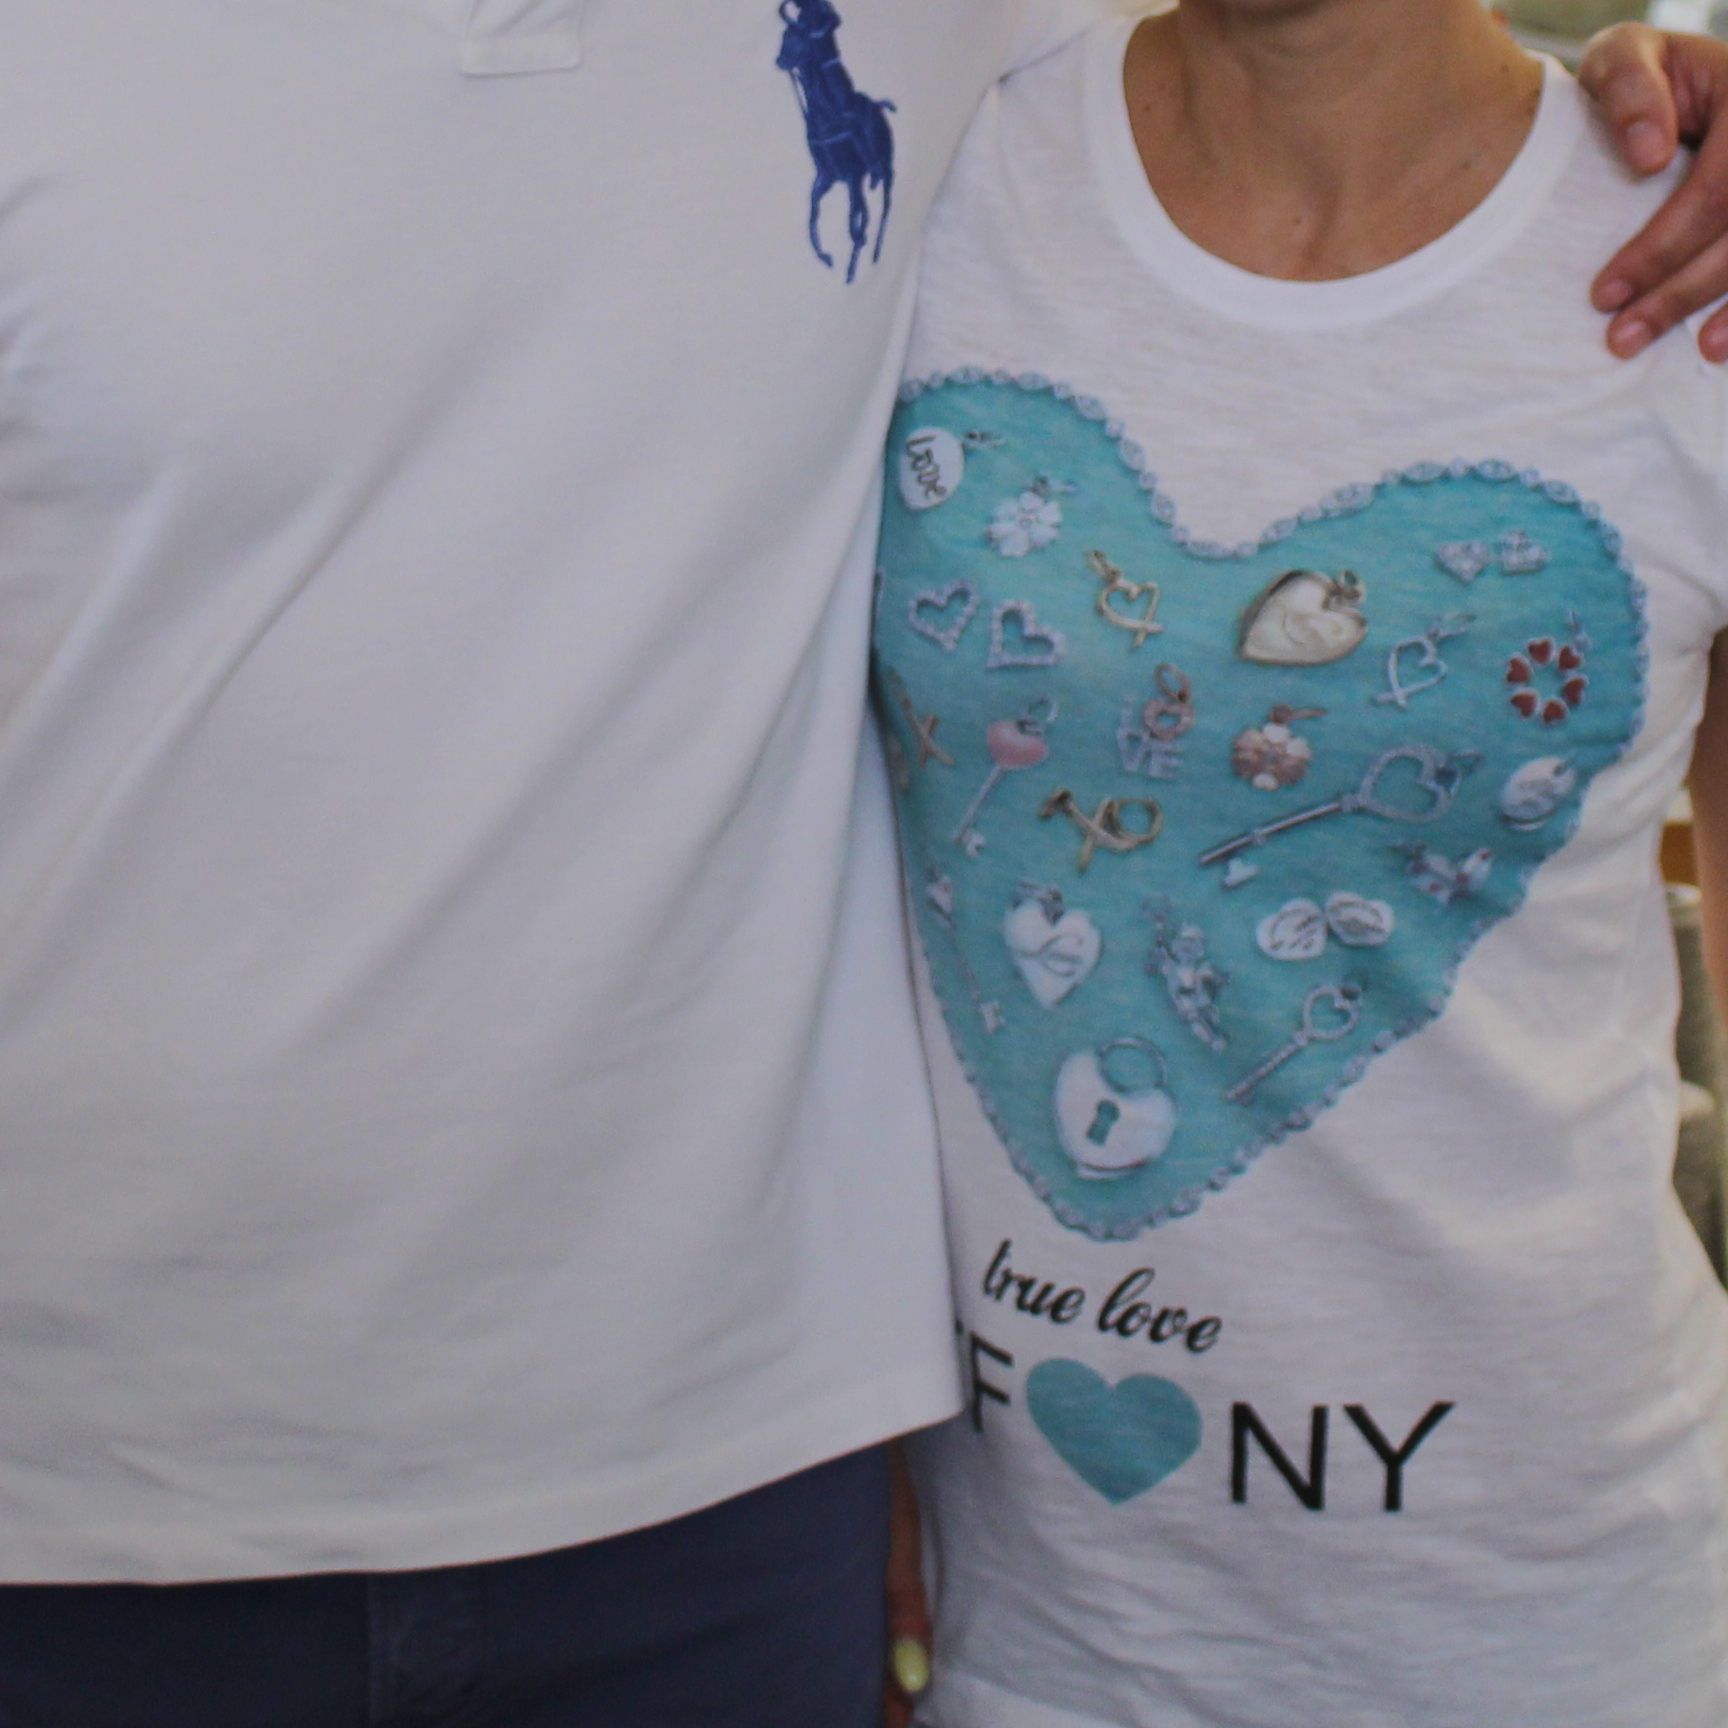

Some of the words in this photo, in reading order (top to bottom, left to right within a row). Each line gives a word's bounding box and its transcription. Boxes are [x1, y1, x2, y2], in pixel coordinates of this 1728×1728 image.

[982, 1238, 1086, 1324] true
[1097, 1267, 1223, 1354] love
[1230, 1401, 1456, 1513] NY
